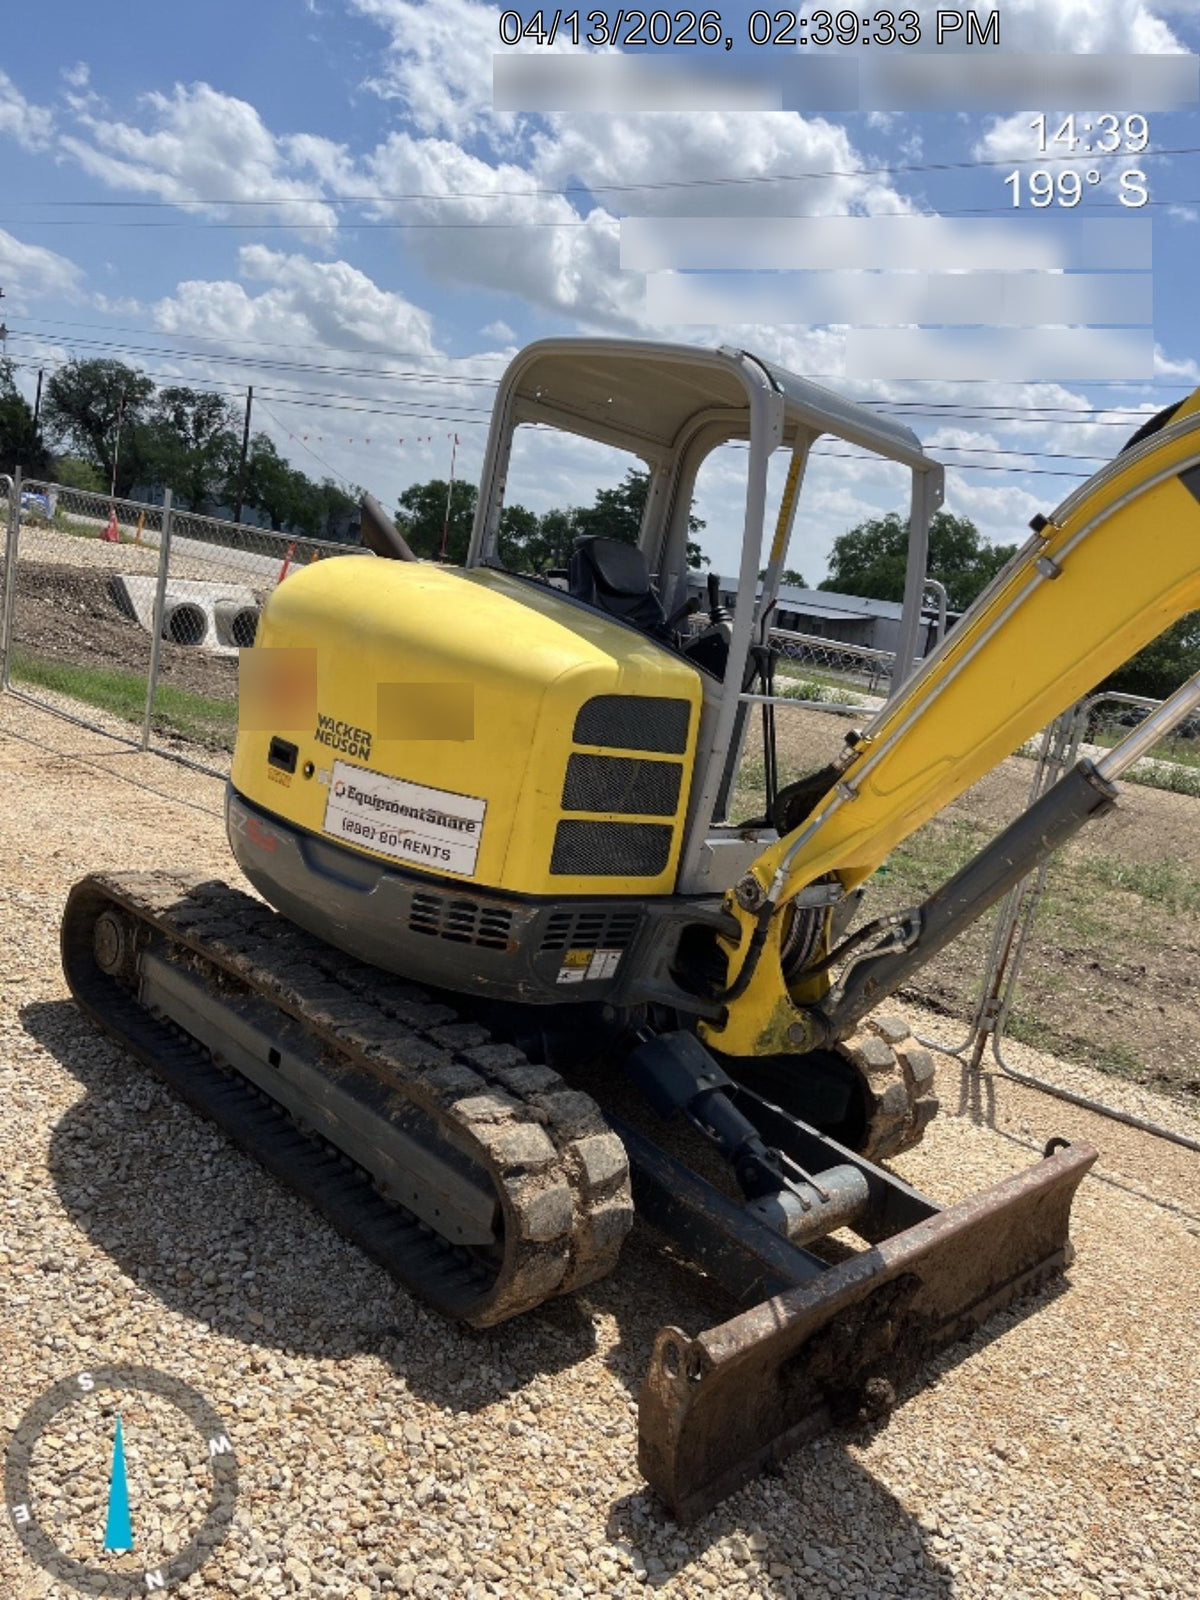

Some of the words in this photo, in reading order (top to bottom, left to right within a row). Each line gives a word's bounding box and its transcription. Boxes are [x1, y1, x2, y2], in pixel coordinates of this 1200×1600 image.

[314, 727, 371, 762] NEUSON
[317, 712, 372, 747] WACKER
[347, 785, 476, 833] EquipmentShare
[379, 831, 451, 861] 80-RENTS
